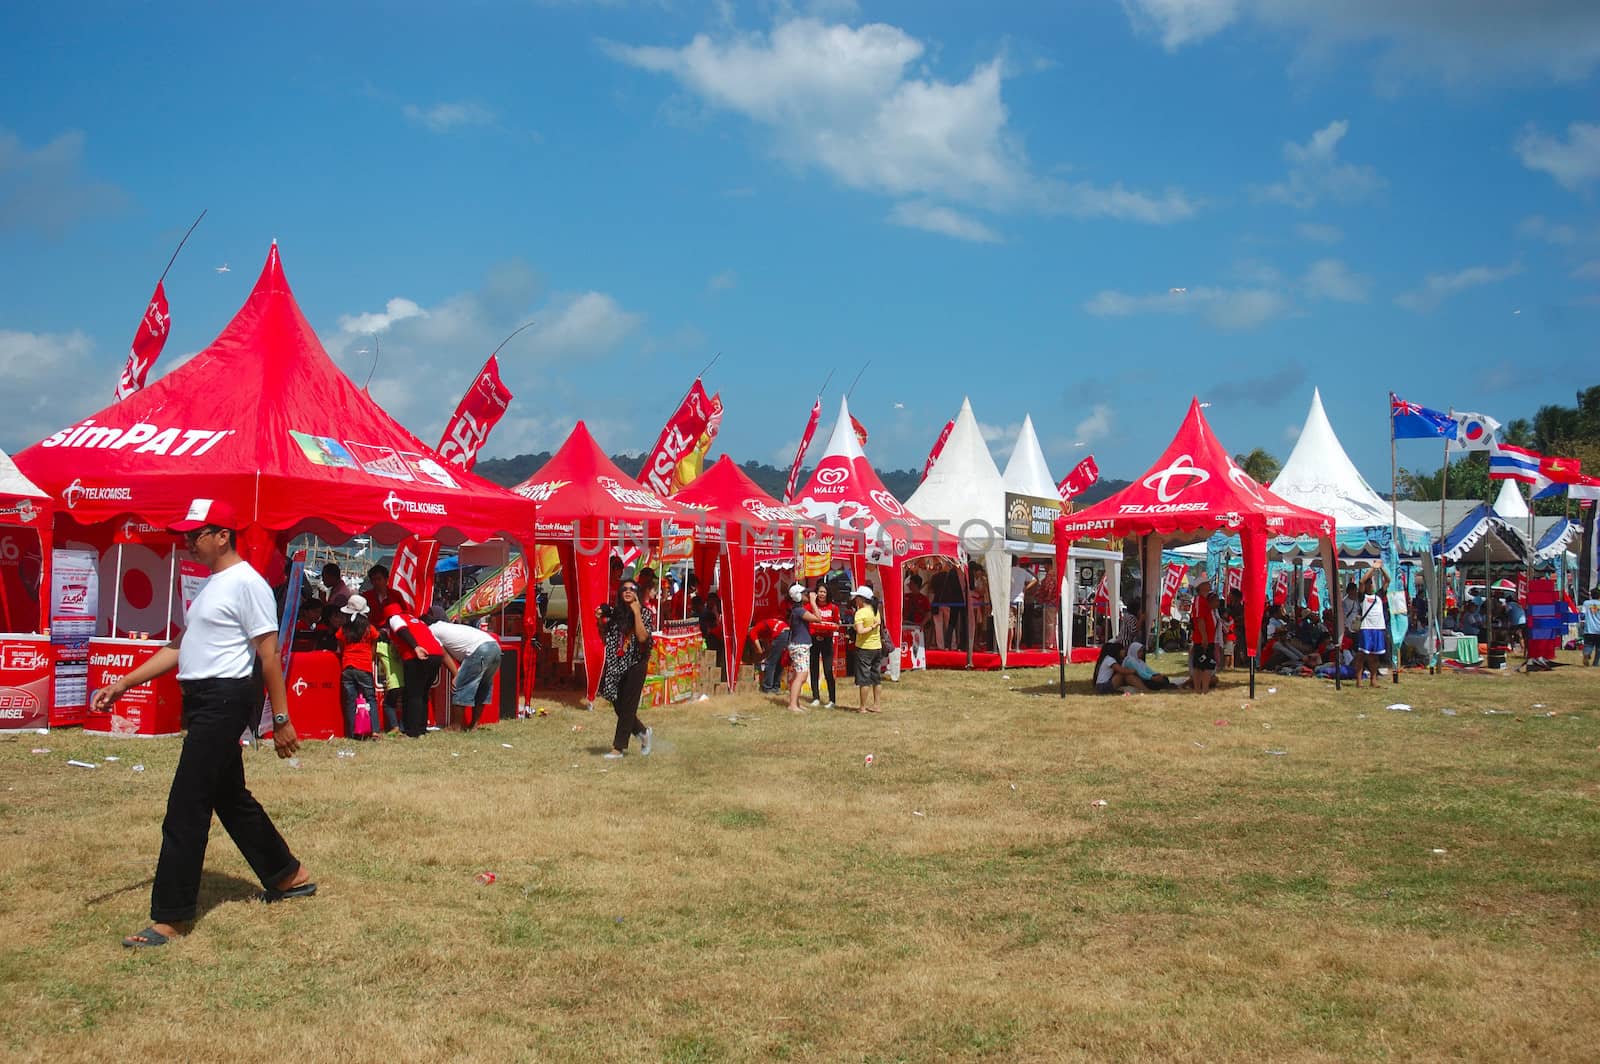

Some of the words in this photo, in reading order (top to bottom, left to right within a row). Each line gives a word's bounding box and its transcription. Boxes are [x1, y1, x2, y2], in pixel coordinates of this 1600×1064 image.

[42, 420, 229, 456] simPATI
[85, 487, 132, 500] TELKOMSEL
[813, 486, 845, 494] WALL'S
[404, 502, 447, 515] TELKOMSEL
[1118, 502, 1209, 514] TELKOMSEL
[1032, 520, 1051, 535] BOOTH
[1064, 519, 1114, 531] simPATI
[90, 652, 134, 667] simPATI
